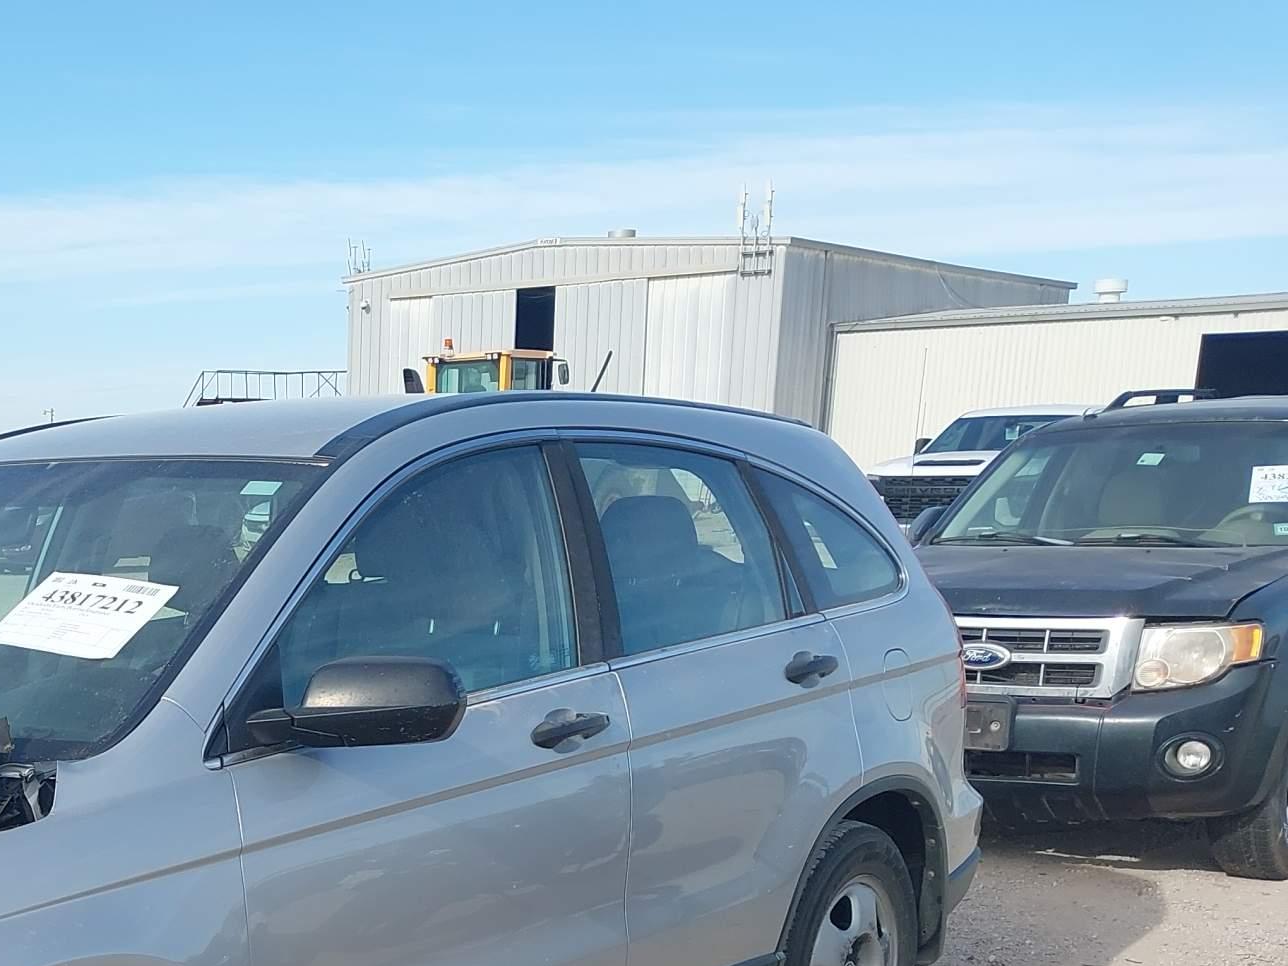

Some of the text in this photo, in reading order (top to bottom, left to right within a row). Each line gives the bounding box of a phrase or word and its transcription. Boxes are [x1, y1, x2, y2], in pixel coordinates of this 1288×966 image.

[1260, 473, 1288, 481] 438
[42, 589, 144, 614] 43817212
[963, 649, 993, 662] Ford
